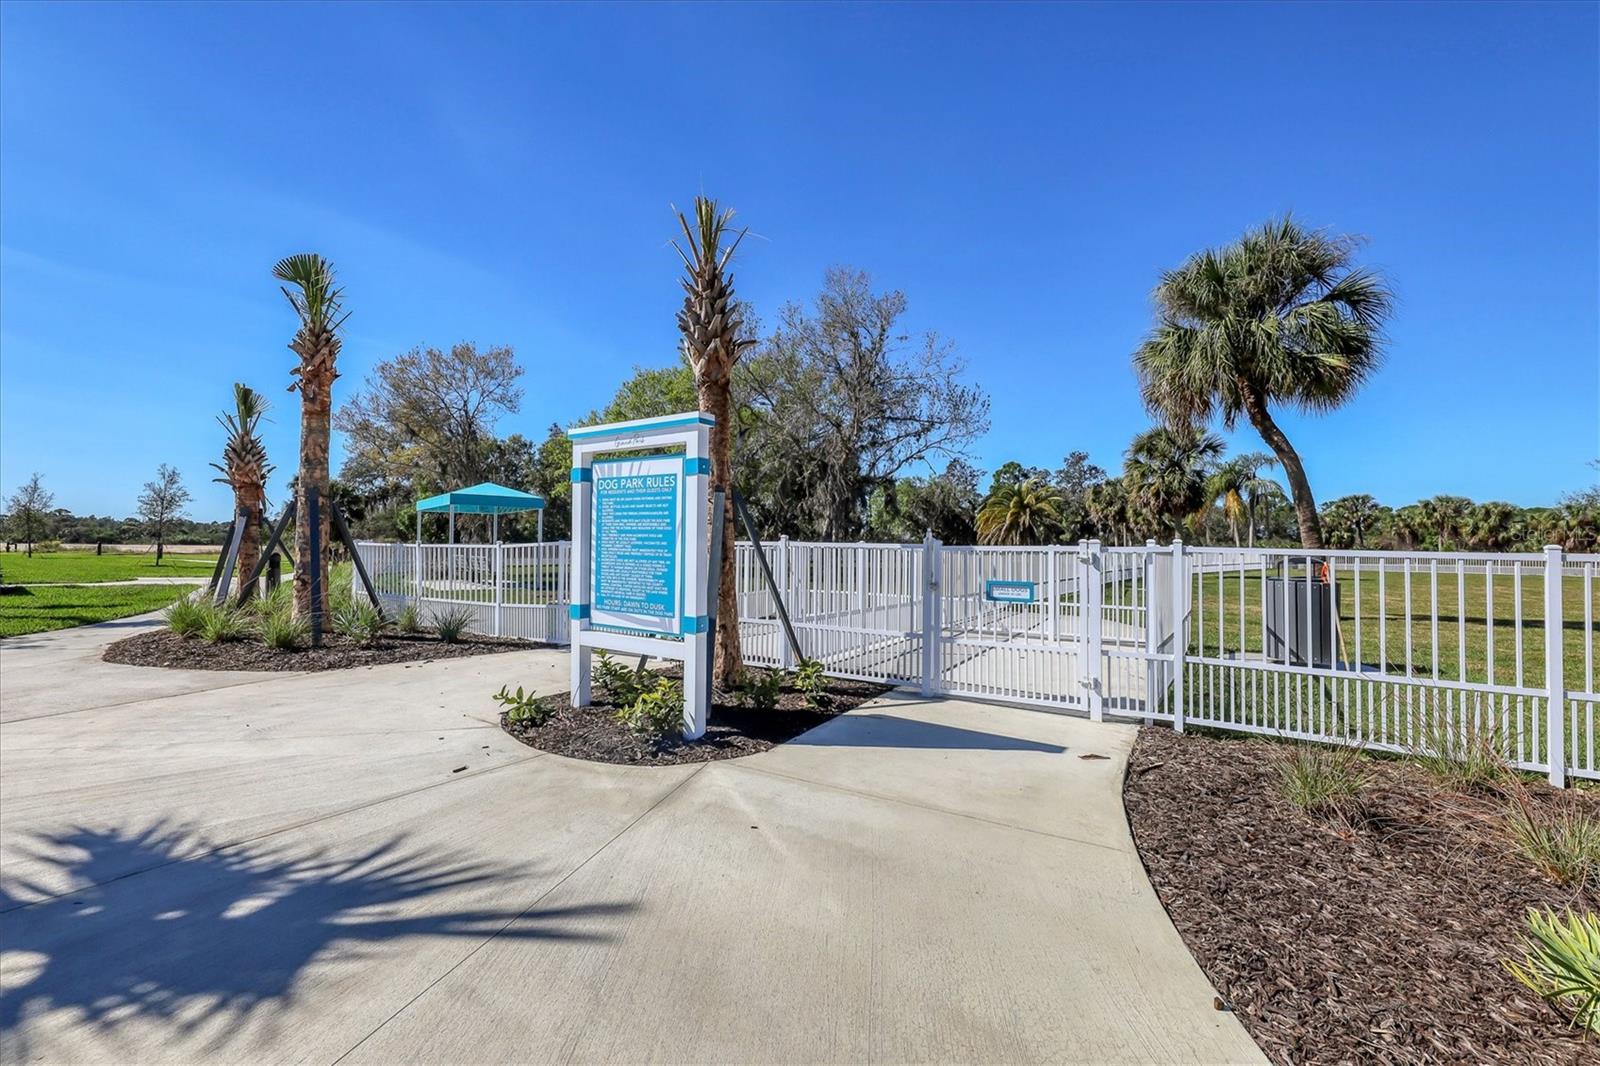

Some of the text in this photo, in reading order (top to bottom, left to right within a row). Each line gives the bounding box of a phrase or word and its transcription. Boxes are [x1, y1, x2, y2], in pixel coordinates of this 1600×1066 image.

[598, 476, 675, 489] DOG PARK RULES
